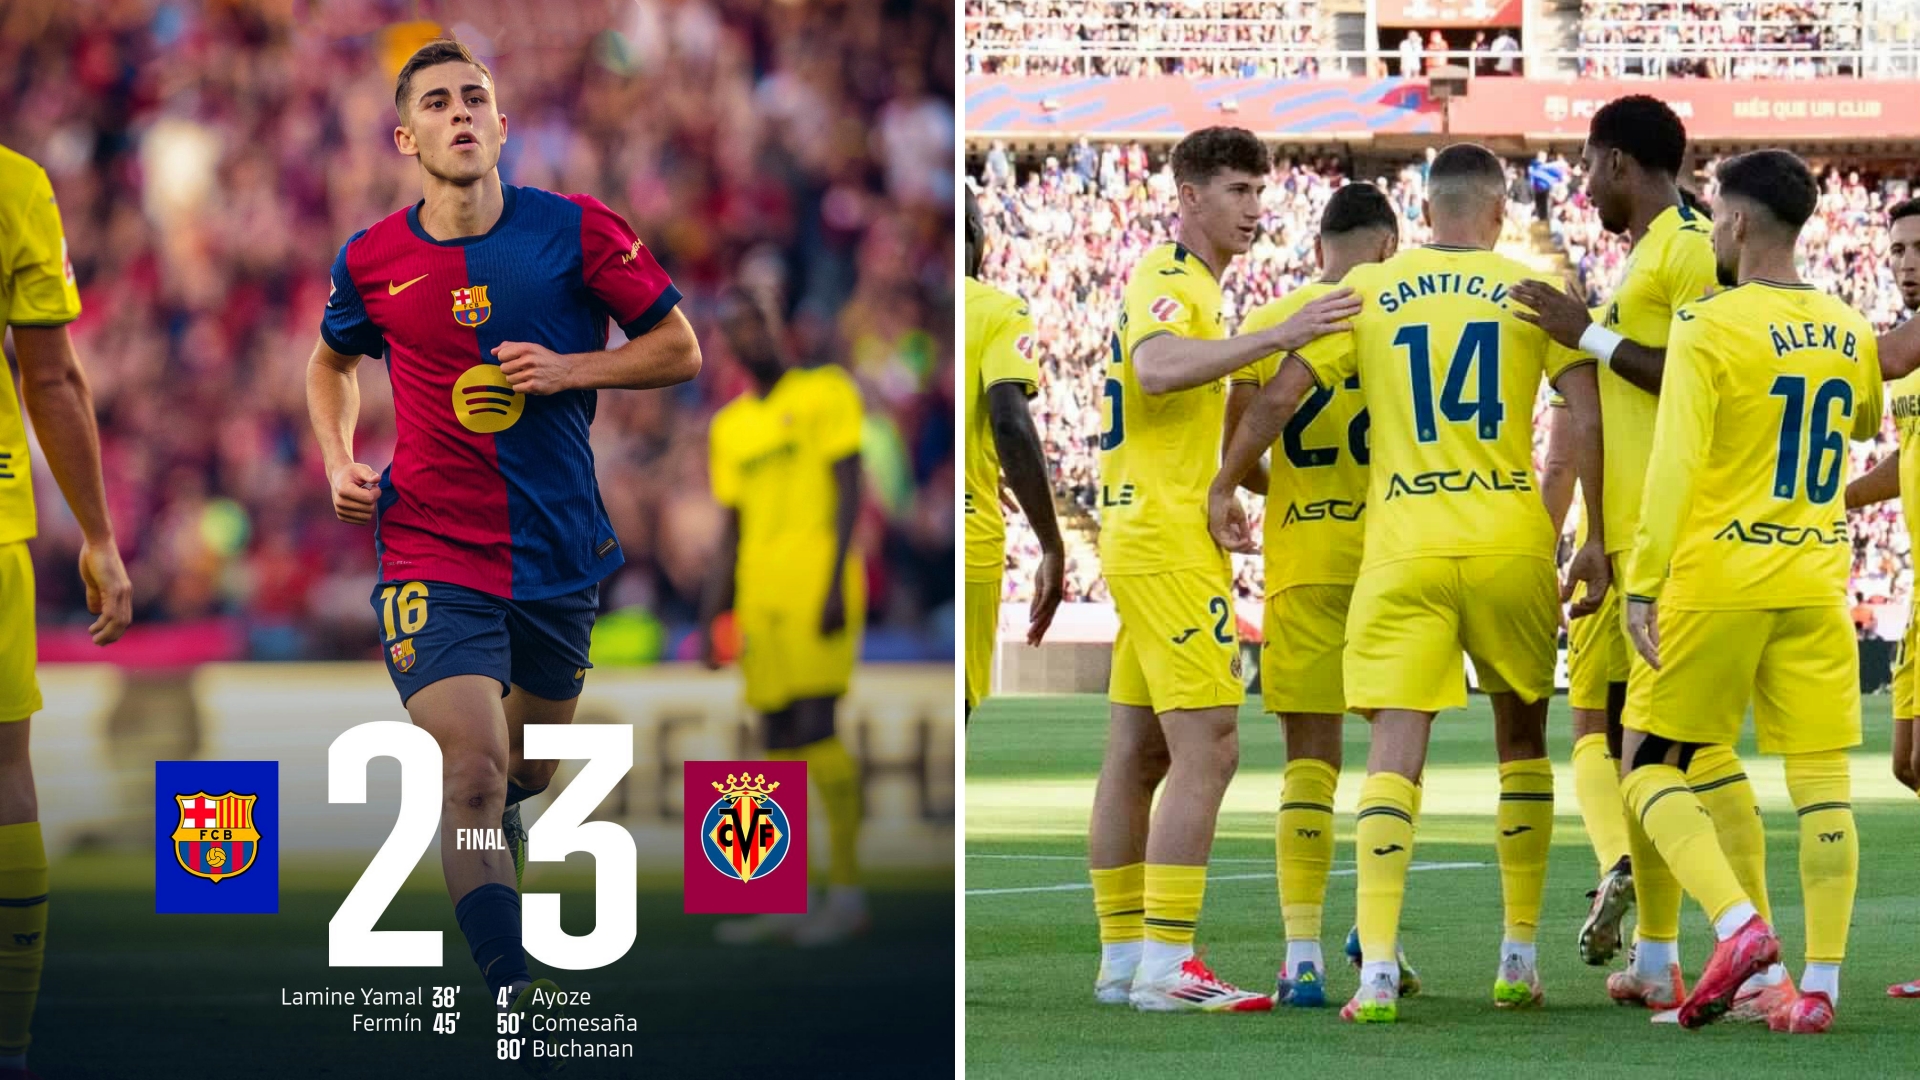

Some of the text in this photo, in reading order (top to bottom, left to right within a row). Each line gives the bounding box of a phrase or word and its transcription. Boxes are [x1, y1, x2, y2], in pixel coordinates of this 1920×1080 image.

[1772, 101, 1806, 120] QUE
[1378, 273, 1461, 313] SANTI
[1769, 323, 1837, 358] ÁLEX
[1393, 321, 1504, 442] 14
[1768, 375, 1854, 505] 16
[1385, 468, 1532, 501] ASCALE
[380, 581, 429, 642] 16
